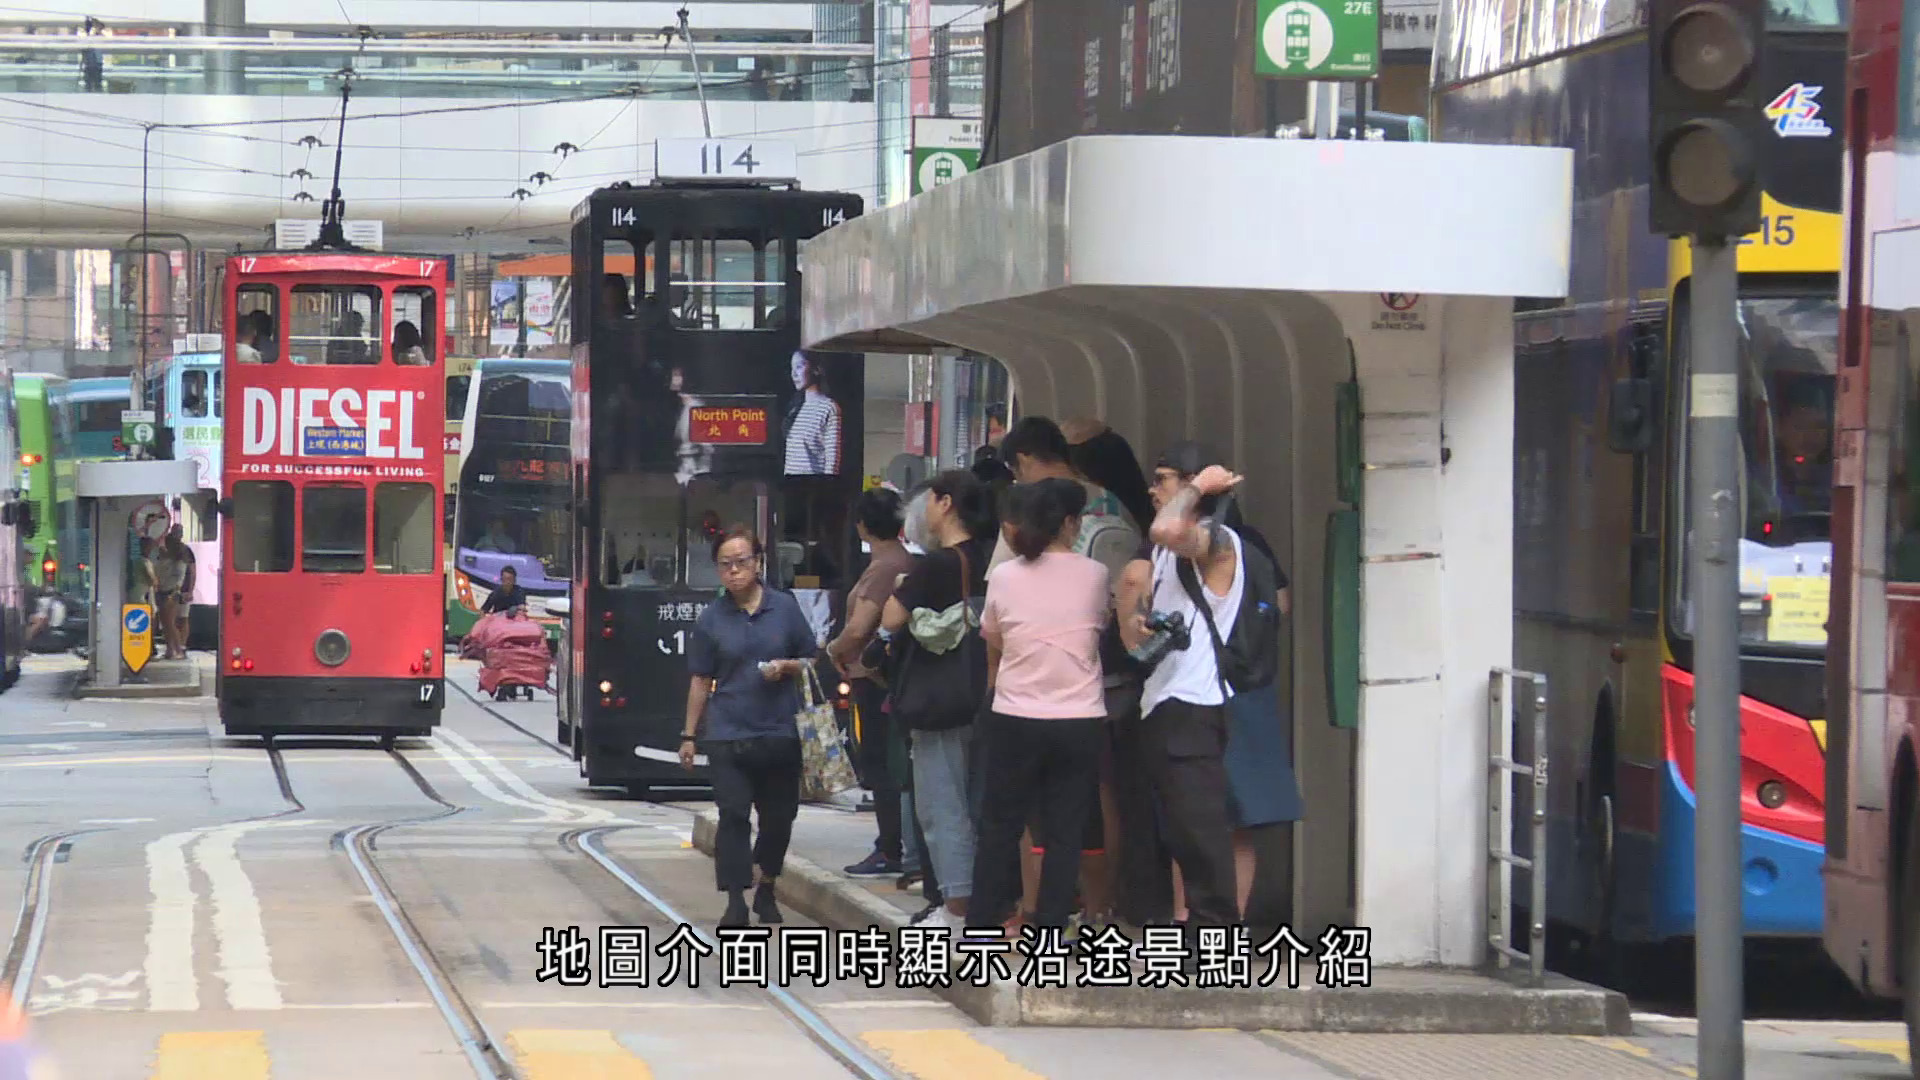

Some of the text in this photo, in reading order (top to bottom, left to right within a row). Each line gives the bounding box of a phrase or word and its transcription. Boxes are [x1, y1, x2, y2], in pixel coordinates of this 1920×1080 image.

[702, 144, 760, 174] 114
[612, 208, 637, 226] 114
[822, 208, 846, 226] 114
[240, 257, 256, 273] 17
[419, 260, 434, 277] 17
[242, 386, 425, 460] DIESEL
[692, 409, 765, 421] North Point
[339, 428, 365, 438] Market
[242, 464, 424, 476] FOR SUCCESSFUL LIVING
[420, 684, 434, 702] 17
